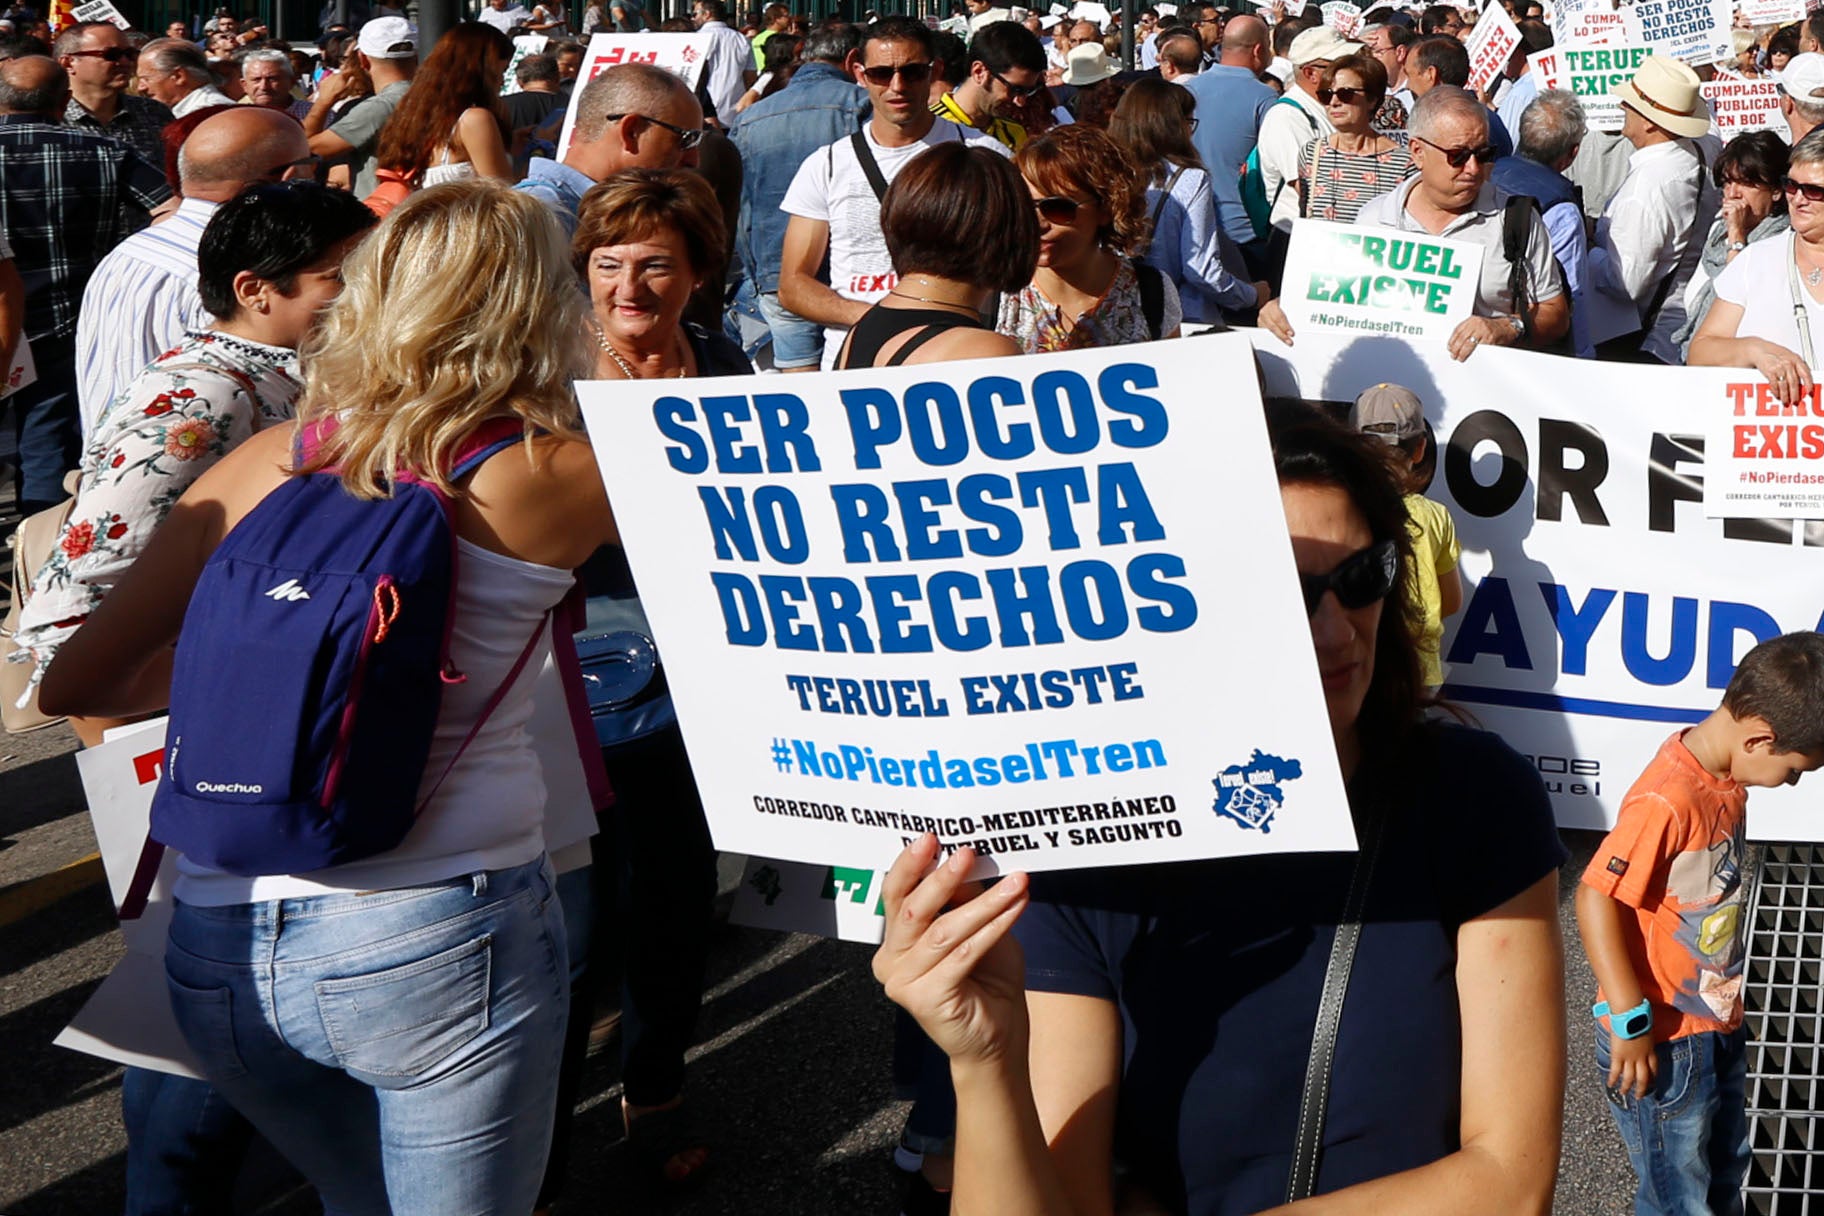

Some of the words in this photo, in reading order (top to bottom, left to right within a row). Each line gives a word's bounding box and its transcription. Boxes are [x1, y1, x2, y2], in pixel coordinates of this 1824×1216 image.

[1584, 14, 1624, 24] CUMPL
[1635, 3, 1664, 18] SER
[1642, 16, 1661, 30] NO
[1665, 8, 1712, 28] RESTA
[1642, 18, 1716, 42] DERECHOS
[1717, 115, 1735, 127] EN
[1740, 114, 1766, 125] BOE
[1310, 313, 1424, 335] #NoPierdaselTren
[651, 392, 821, 476] SER
[839, 362, 1170, 470] POCOS
[1726, 493, 1762, 501] CORREDOR
[697, 484, 810, 565] NO
[830, 461, 1165, 563] RESTA
[709, 552, 1199, 654] DERECHOS
[787, 673, 949, 718] TERUEL
[960, 661, 1145, 716] EXISTE
[771, 737, 1168, 791] #NoPierdaselTren
[195, 781, 263, 794] Quechua
[753, 794, 849, 824] CORREDOR
[851, 794, 1178, 837] CANTÁBRICO-MEDITERRÁNEO
[1043, 833, 1060, 849] Y
[1069, 819, 1183, 847] SAGUNTO
